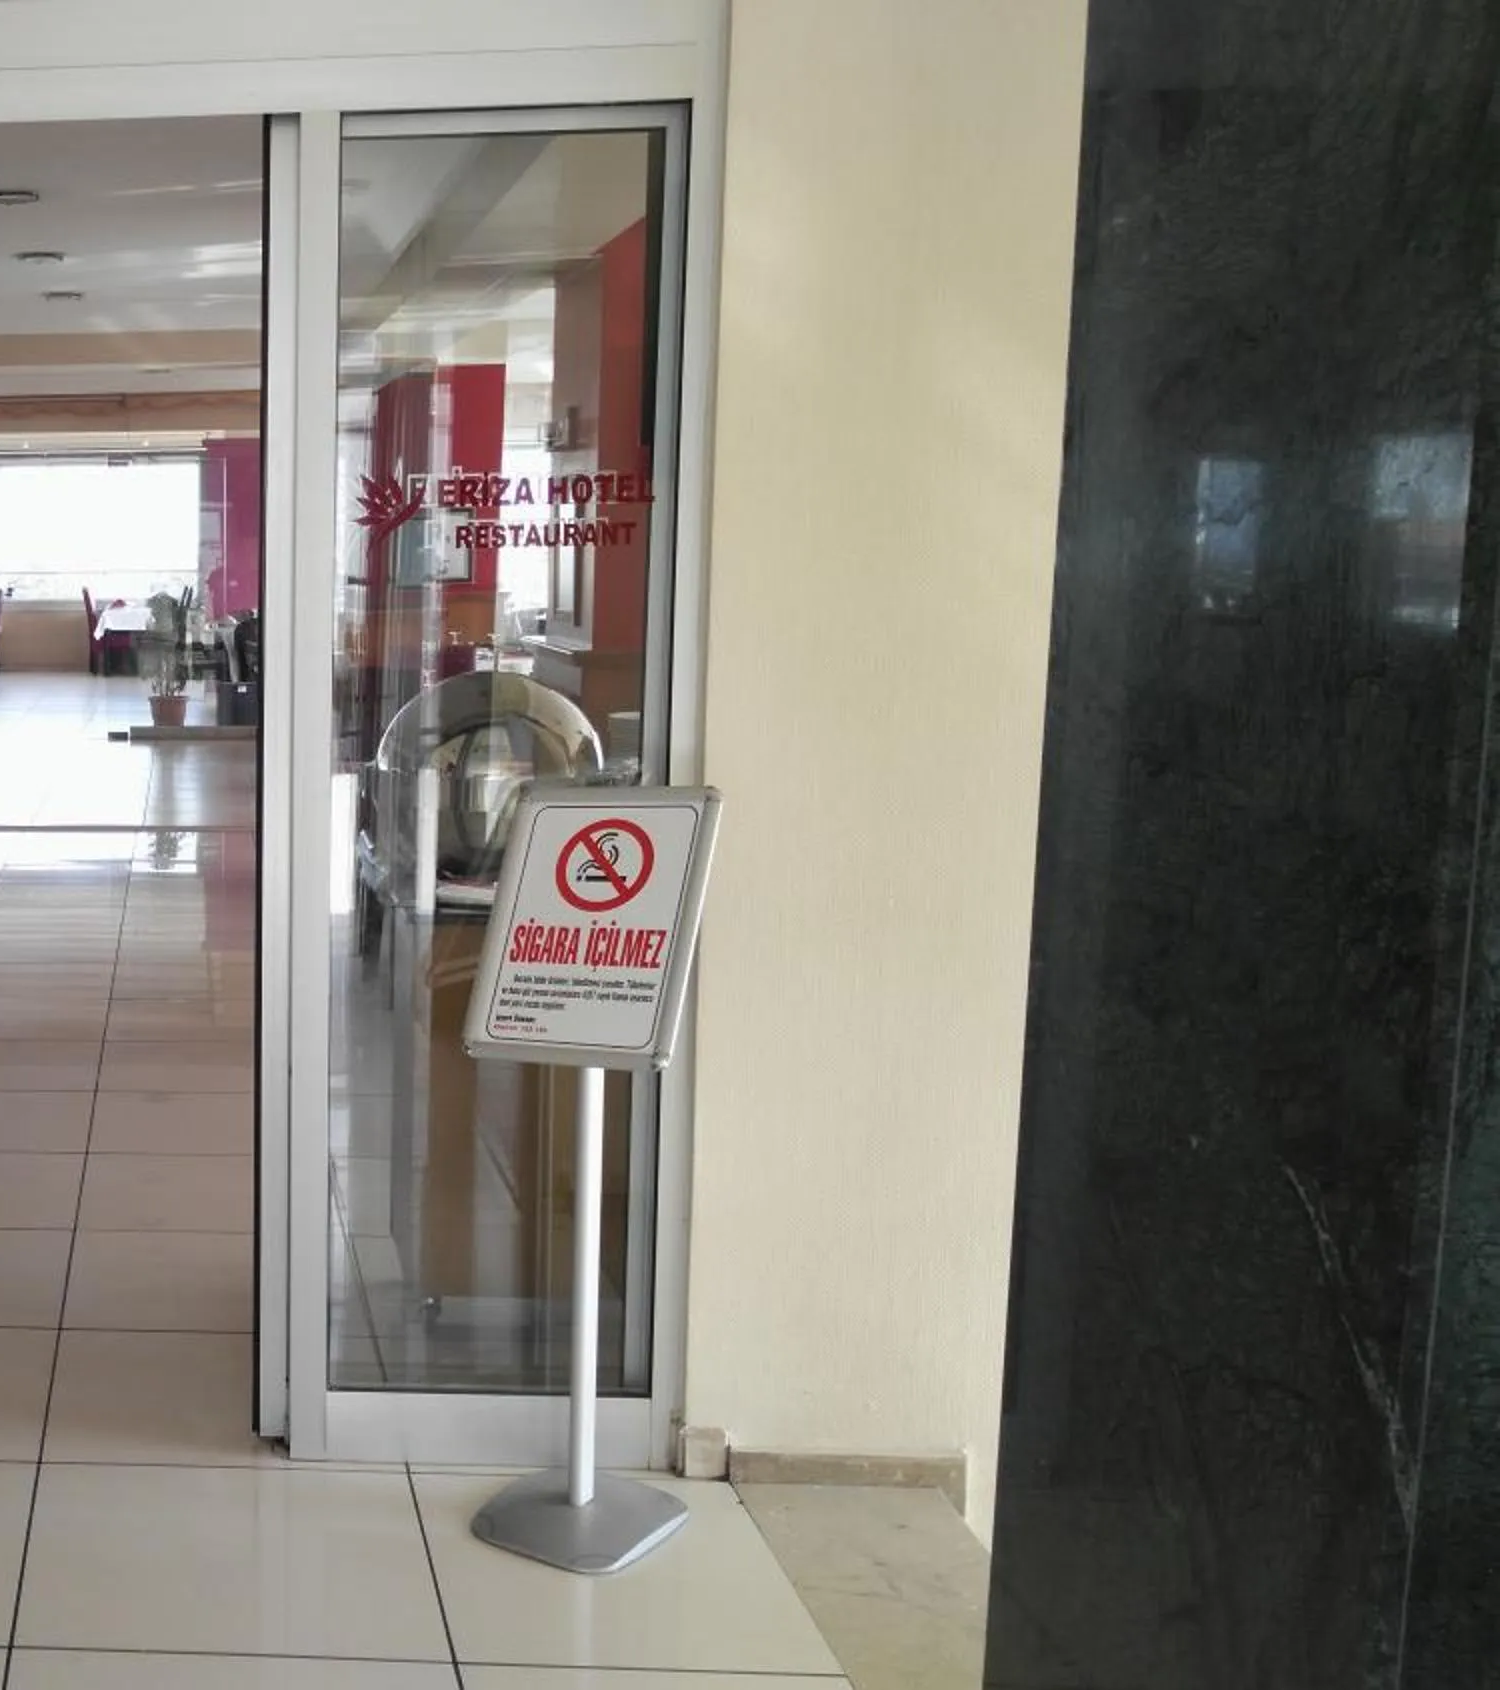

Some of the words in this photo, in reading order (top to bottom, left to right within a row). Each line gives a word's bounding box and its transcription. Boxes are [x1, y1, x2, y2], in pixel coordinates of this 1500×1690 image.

[548, 473, 656, 504] HOTEL
[455, 522, 637, 549] RESTAURANT
[509, 918, 581, 965] SİGARA
[583, 919, 668, 972] İÇİLMEZ
